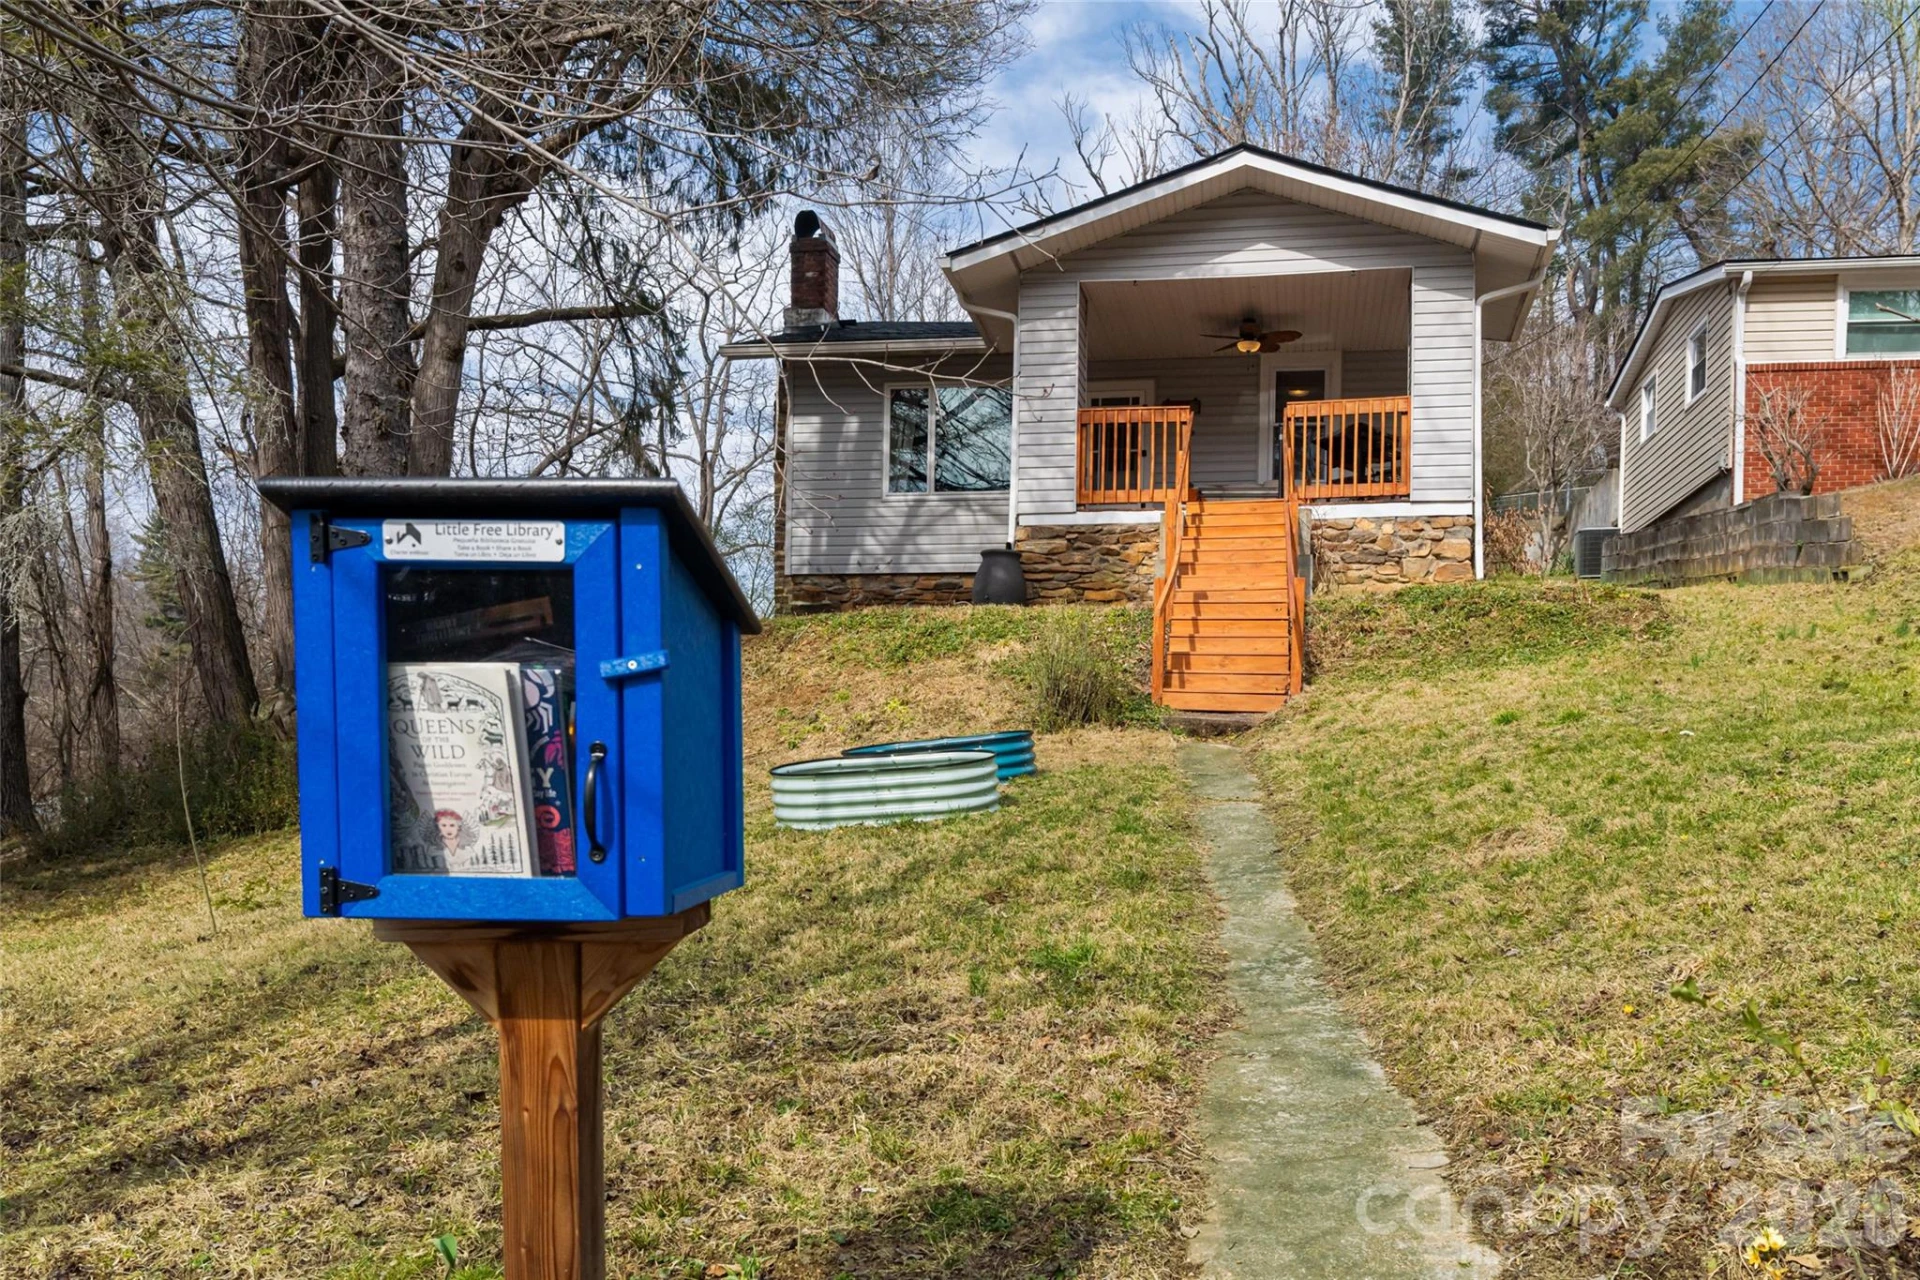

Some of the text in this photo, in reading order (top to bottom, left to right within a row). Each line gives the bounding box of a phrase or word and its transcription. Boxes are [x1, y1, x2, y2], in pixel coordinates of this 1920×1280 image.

[435, 522, 554, 540] Little Free Library
[393, 717, 476, 739] QUEENS
[410, 745, 465, 759] WILD
